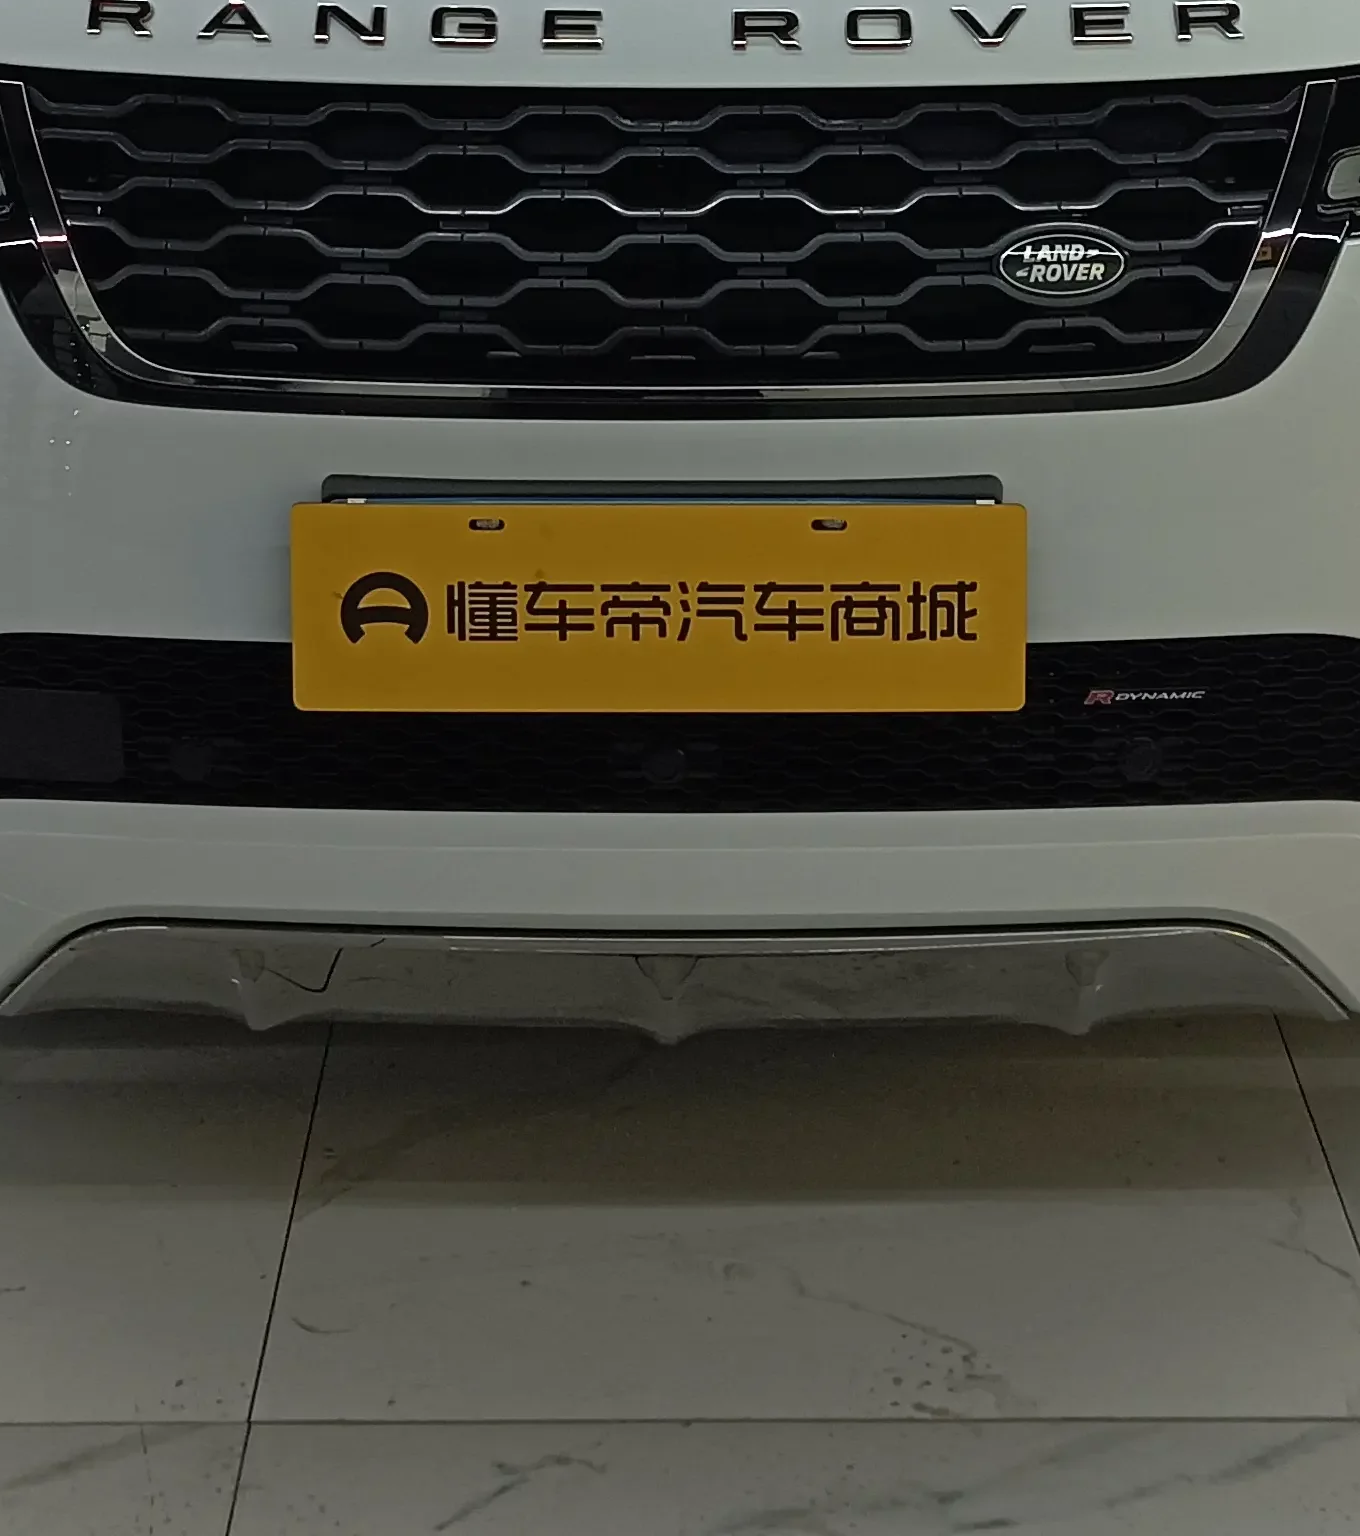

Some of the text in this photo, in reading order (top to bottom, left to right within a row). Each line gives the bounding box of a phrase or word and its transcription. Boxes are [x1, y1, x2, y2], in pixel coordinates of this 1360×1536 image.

[1023, 243, 1086, 263] LAND
[1029, 263, 1106, 283] ROVER
[445, 579, 979, 643] 懂车帝汽车商城
[1115, 691, 1206, 701] DYNAMIC
